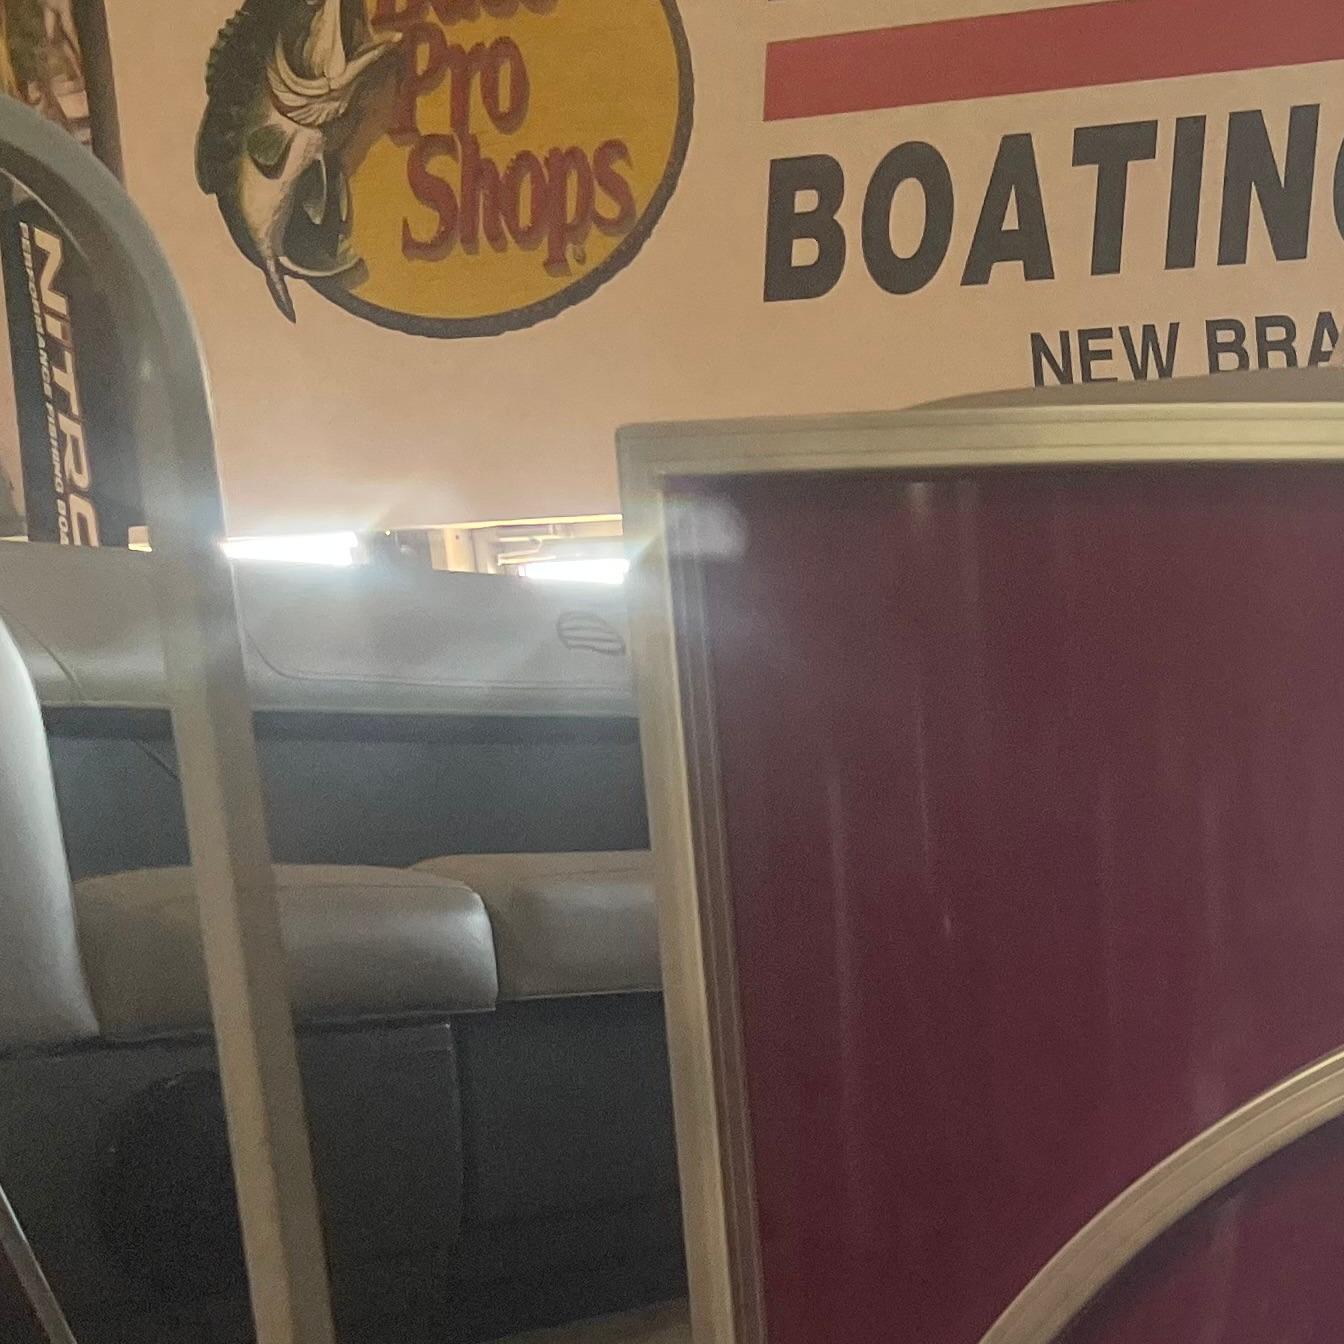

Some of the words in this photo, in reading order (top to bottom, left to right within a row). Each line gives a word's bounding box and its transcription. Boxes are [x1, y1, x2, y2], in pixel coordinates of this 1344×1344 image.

[386, 22, 531, 148] Pro
[402, 133, 637, 277] Shops
[1030, 322, 1180, 388] NEW
[56, 498, 70, 545] BOA
